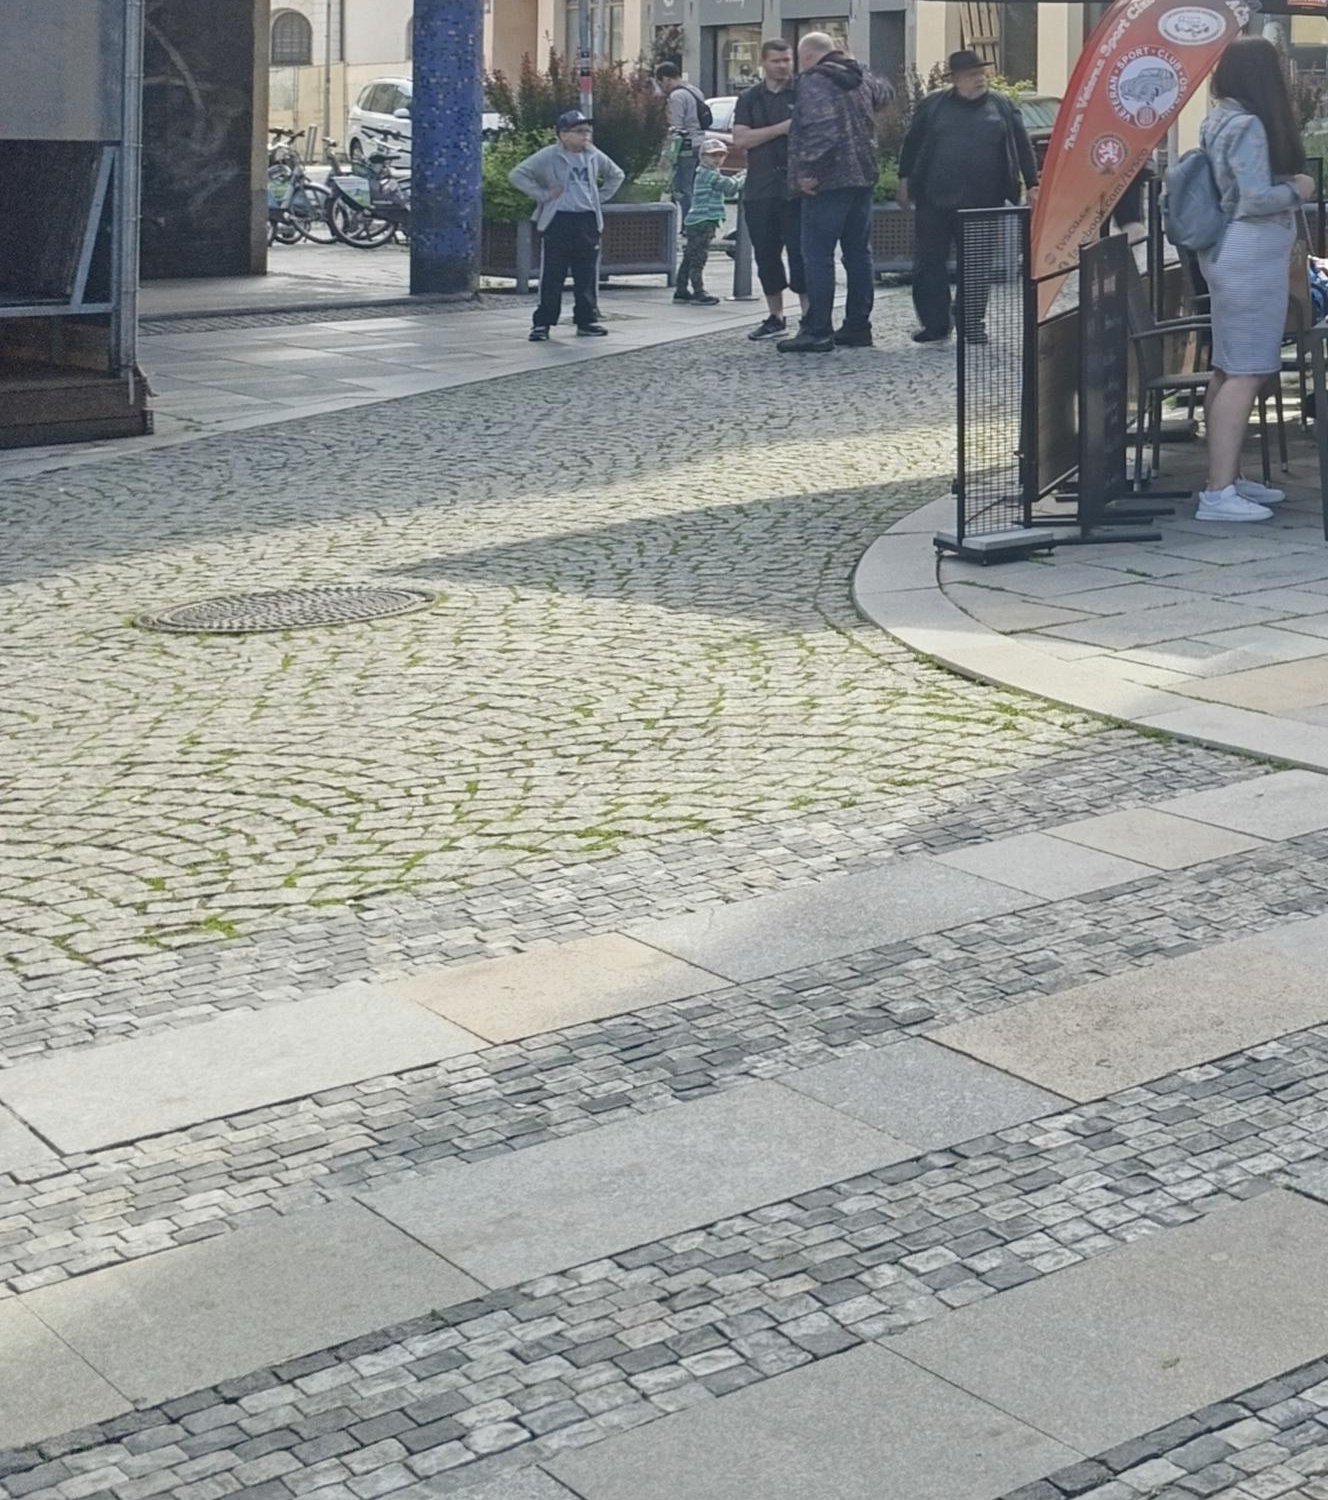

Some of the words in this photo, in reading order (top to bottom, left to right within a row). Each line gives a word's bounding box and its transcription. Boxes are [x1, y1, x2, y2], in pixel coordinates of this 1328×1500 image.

[1101, 18, 1132, 58] Sport
[1116, 47, 1150, 71] SPORT
[1157, 48, 1182, 71] CLUB
[1108, 75, 1132, 122] VETERAN
